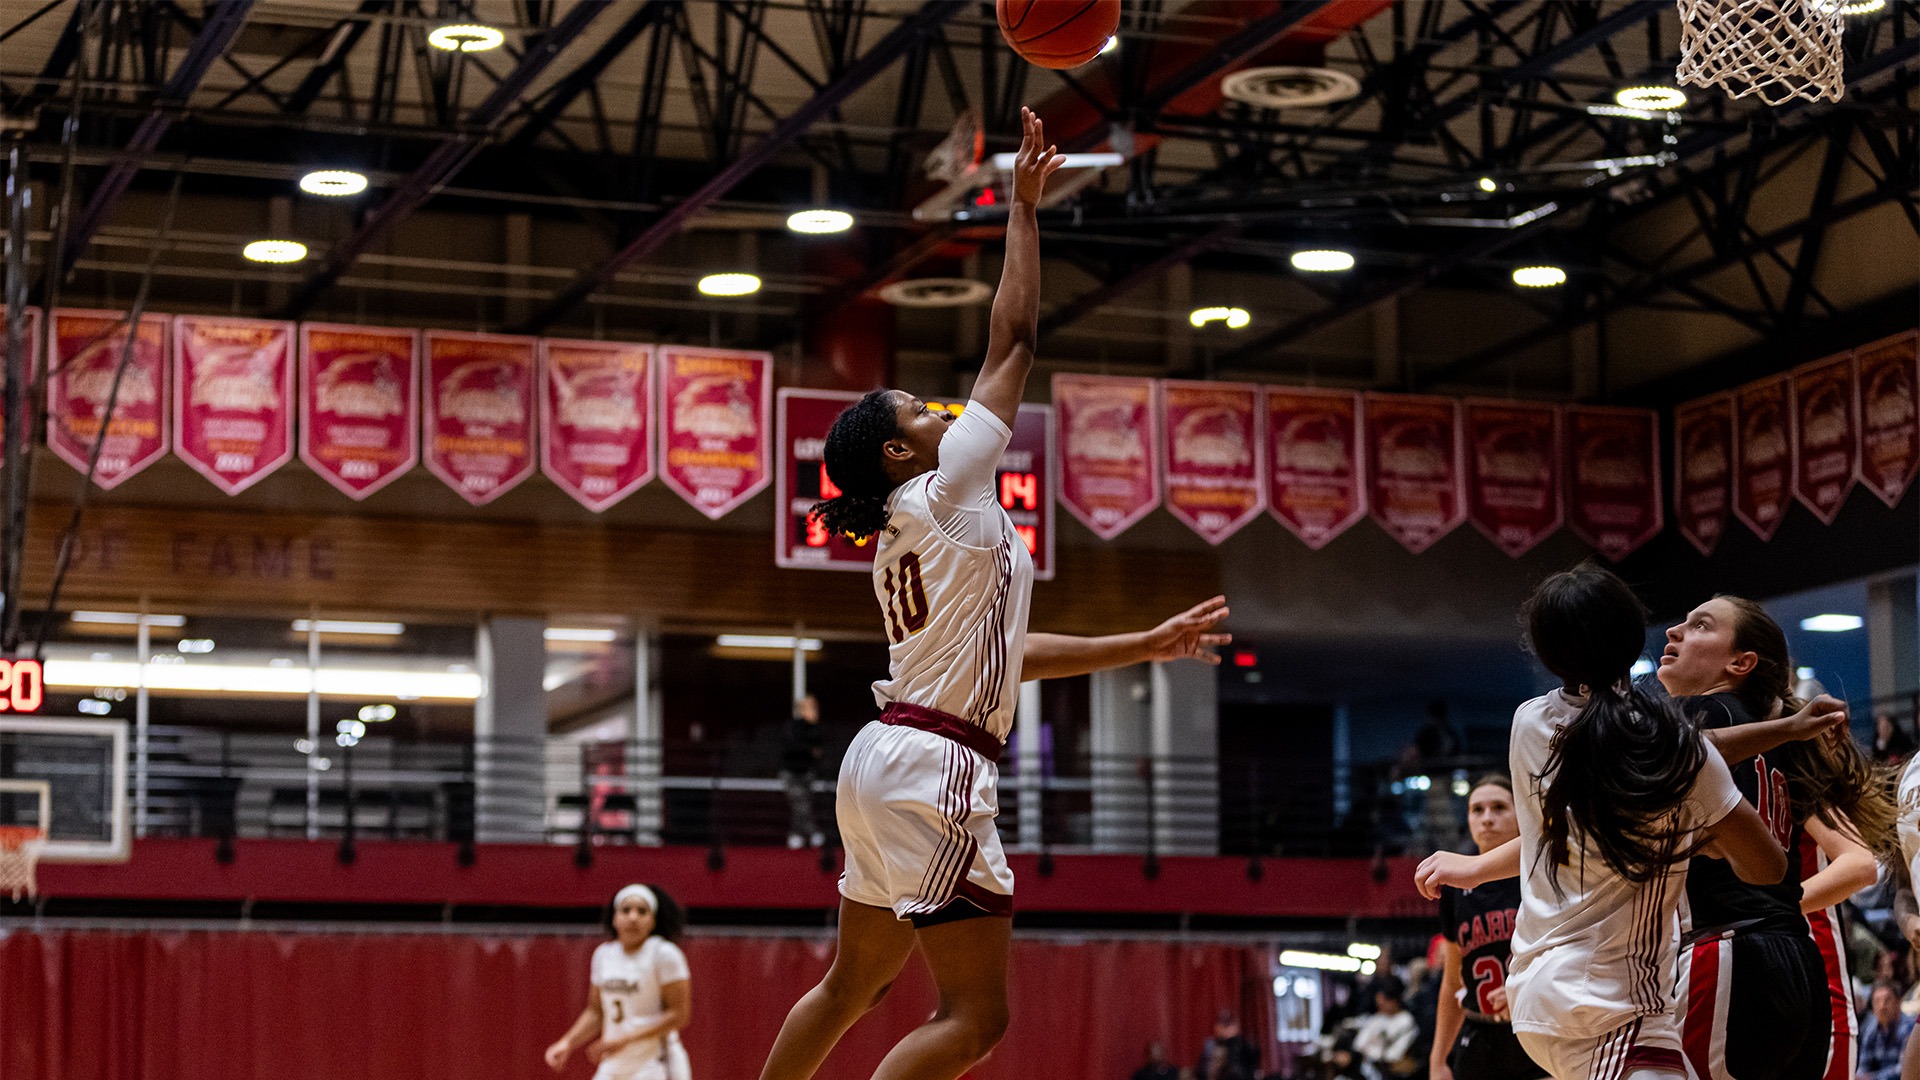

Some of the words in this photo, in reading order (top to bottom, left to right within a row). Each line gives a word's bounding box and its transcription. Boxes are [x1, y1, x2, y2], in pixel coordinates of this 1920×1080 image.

[1001, 472, 1037, 510] 14
[171, 531, 335, 580] FAME
[884, 550, 931, 645] 10
[1472, 954, 1513, 1016] 2
